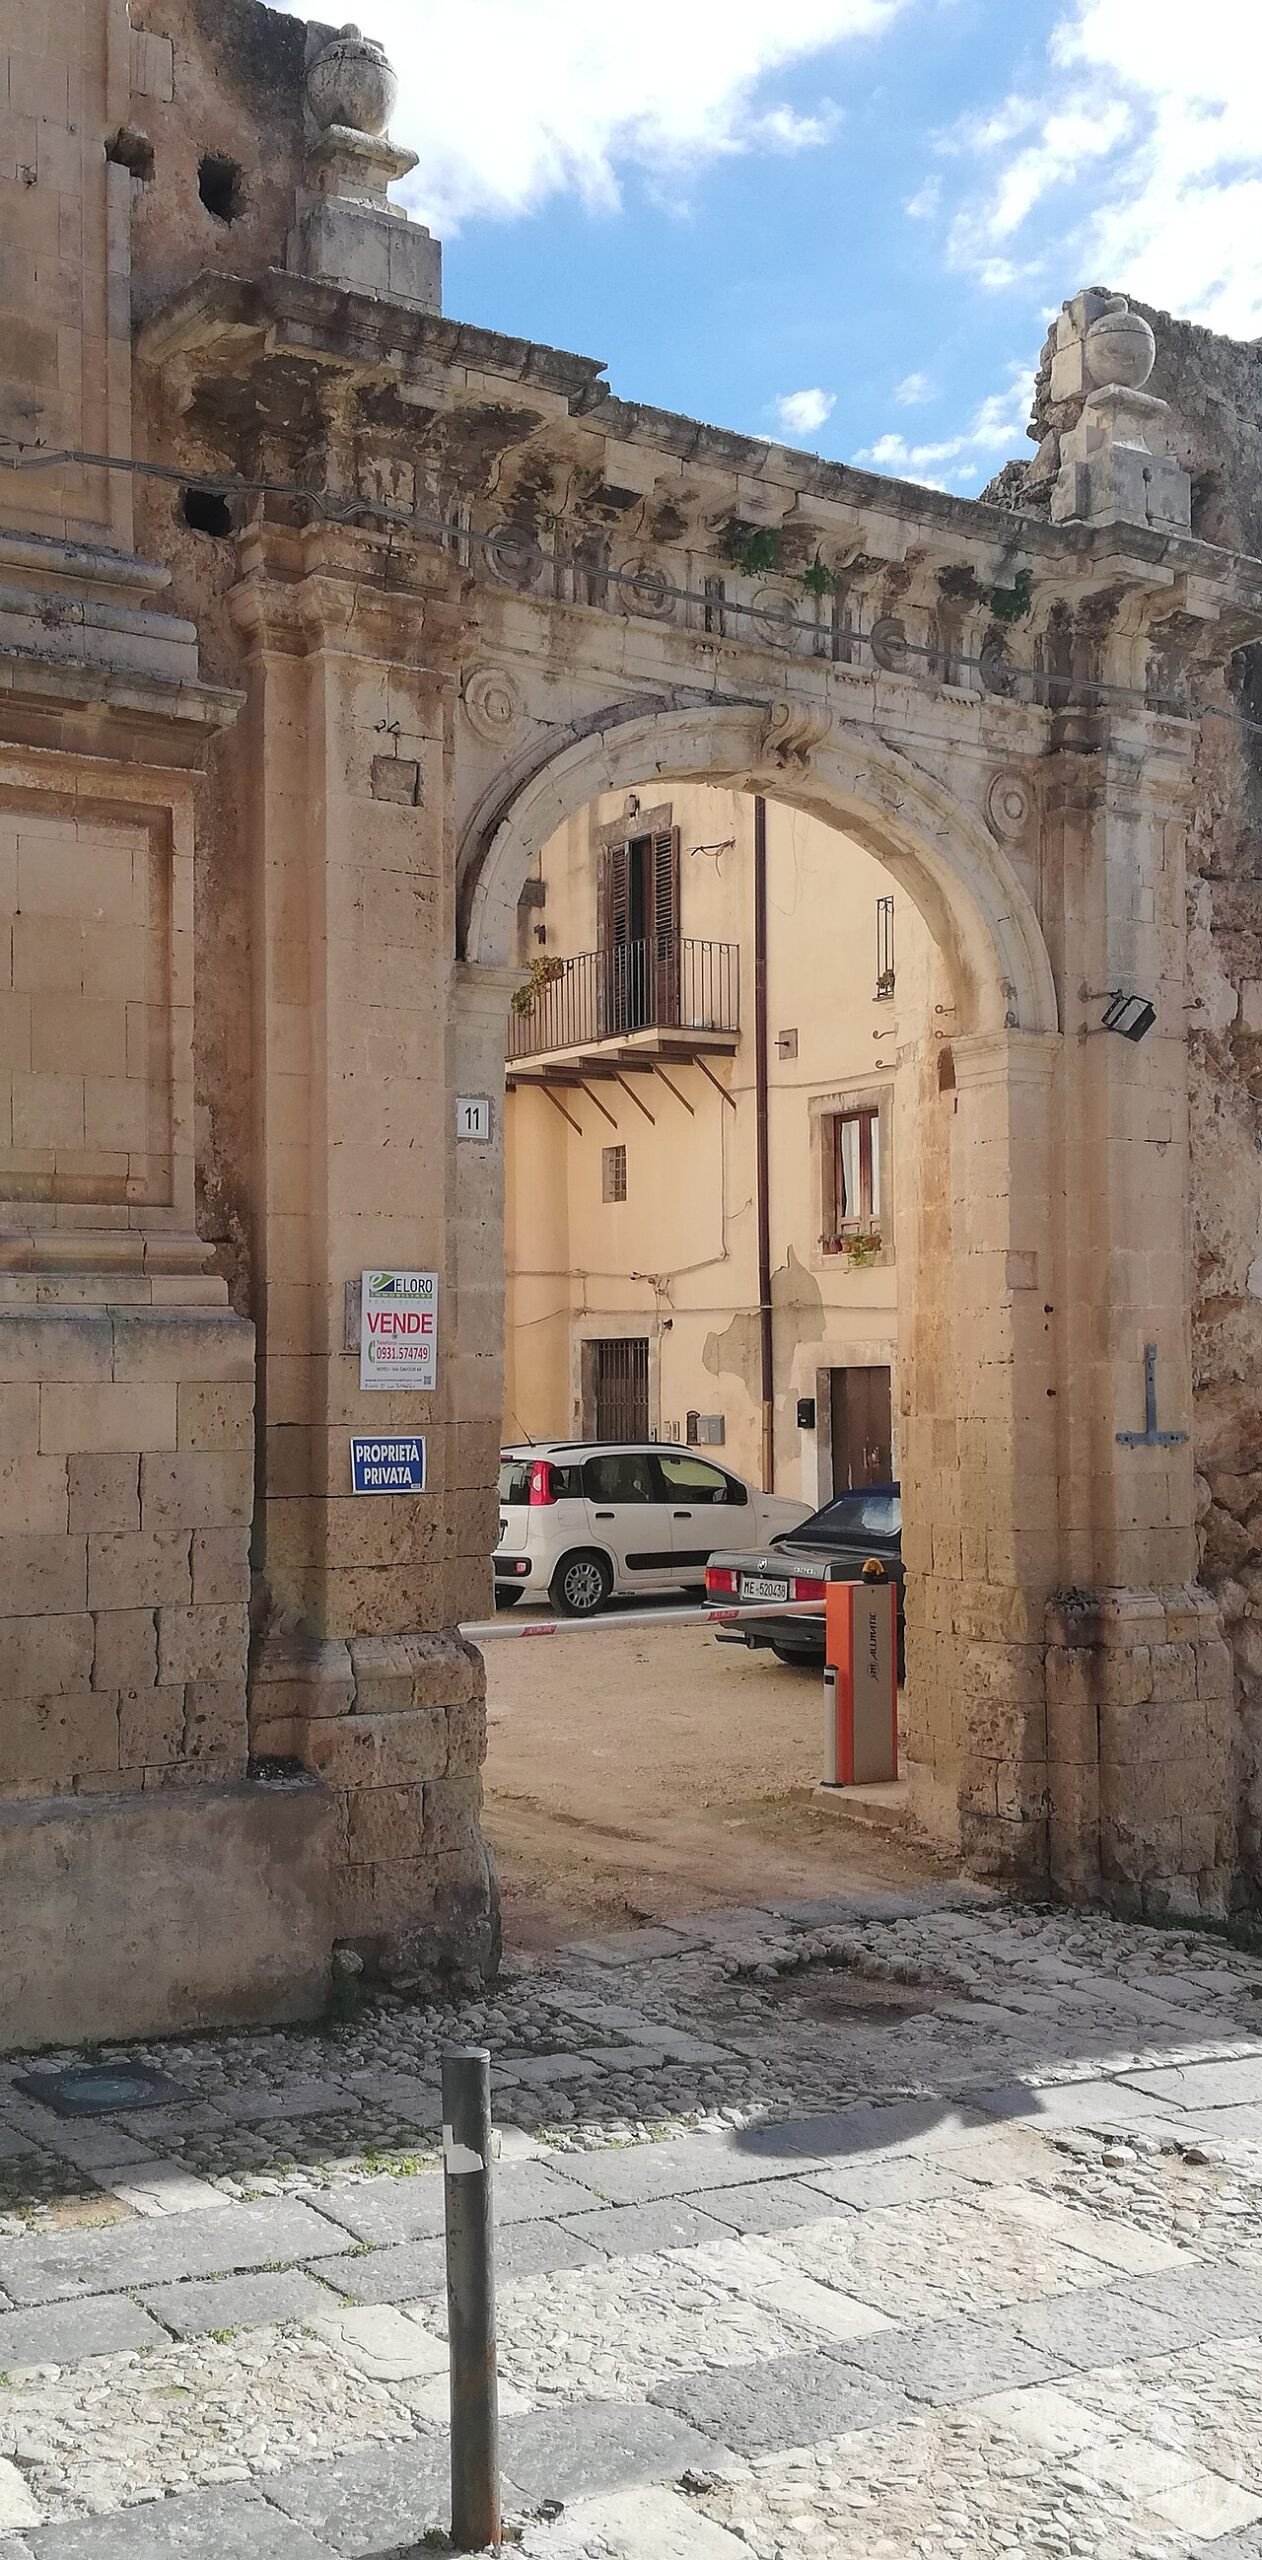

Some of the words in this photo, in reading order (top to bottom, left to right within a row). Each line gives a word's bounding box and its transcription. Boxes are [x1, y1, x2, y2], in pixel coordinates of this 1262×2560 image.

[465, 1107, 479, 1130] 11
[396, 1278, 433, 1293] ELORO
[367, 1312, 433, 1334] VENDE
[376, 1347, 428, 1360] 0931.574749
[356, 1440, 420, 1463] PROPRIETÀ
[364, 1467, 412, 1485] PRIVATA
